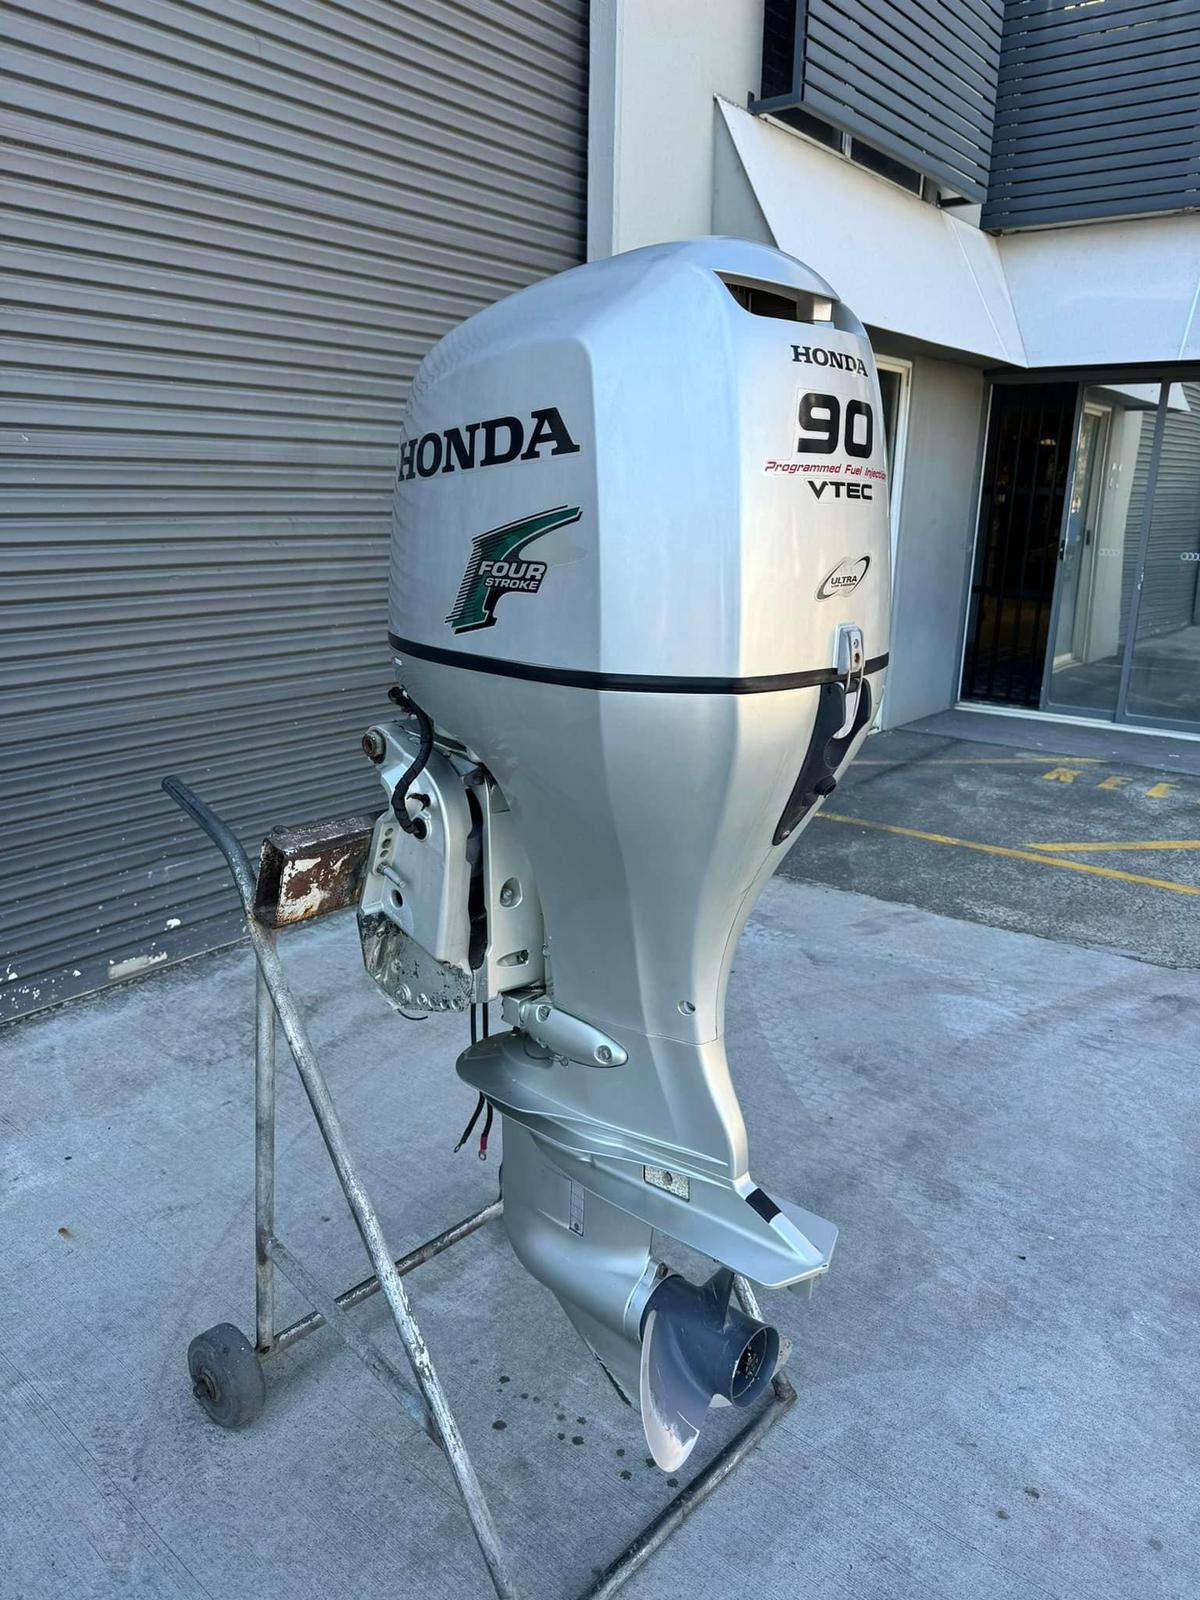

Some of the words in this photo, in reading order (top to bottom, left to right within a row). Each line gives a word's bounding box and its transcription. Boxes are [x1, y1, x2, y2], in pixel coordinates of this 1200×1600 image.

[790, 345, 868, 377] HONDA
[797, 392, 874, 459] 90
[398, 407, 580, 482] HONDA
[765, 461, 842, 474] Programmed
[845, 464, 863, 475] Fuel
[864, 467, 887, 480] Injectio
[808, 480, 873, 500] VTEC
[478, 561, 546, 580] FOUR
[831, 575, 857, 585] ULTRA
[485, 577, 539, 590] STROKE
